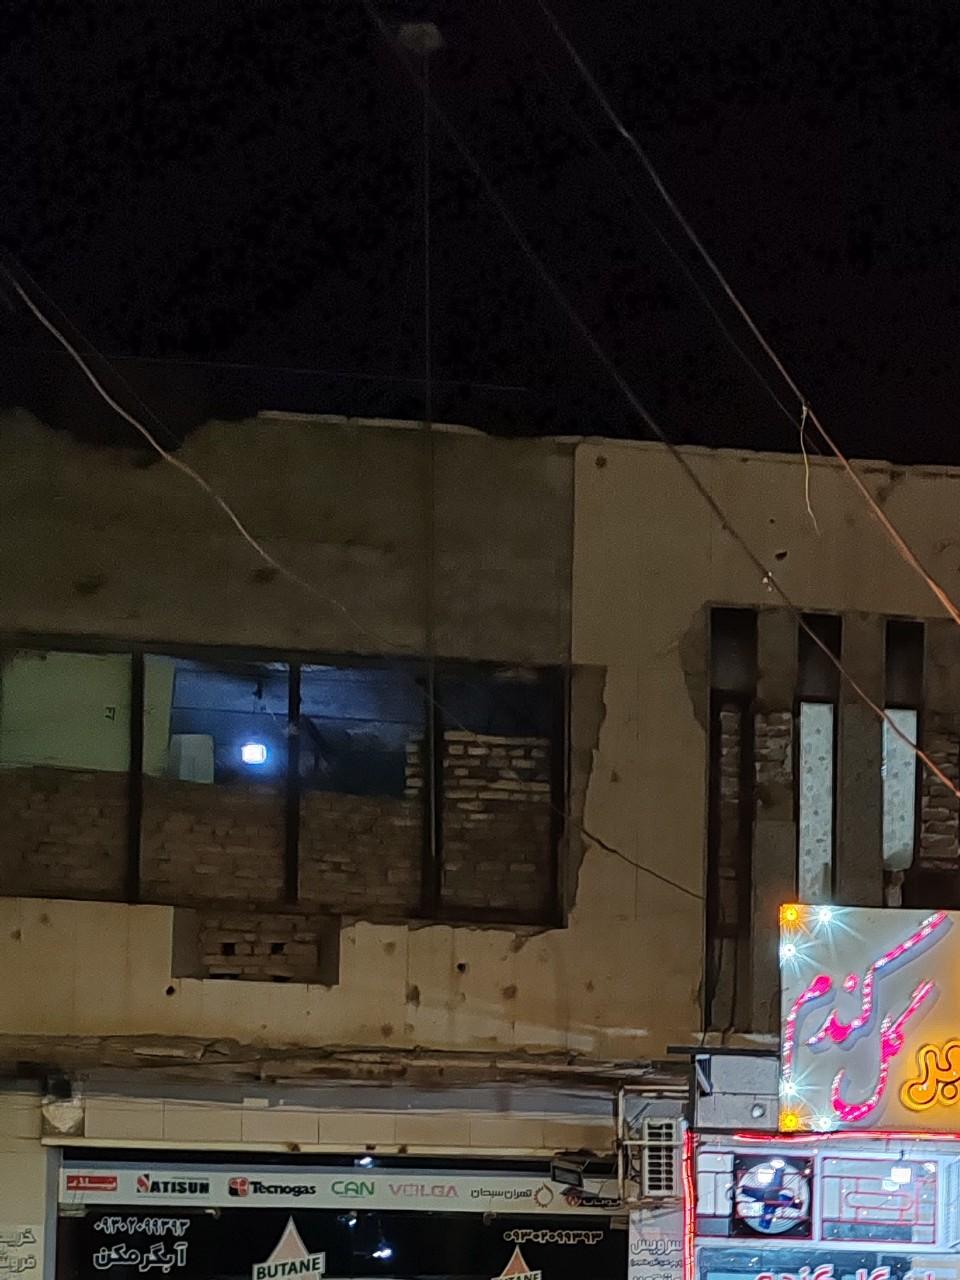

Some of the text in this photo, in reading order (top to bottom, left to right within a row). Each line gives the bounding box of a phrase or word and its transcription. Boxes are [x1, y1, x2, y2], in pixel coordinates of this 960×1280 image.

[249, 1181, 316, 1196] Tecnogas
[331, 1180, 375, 1195] CAN
[93, 1242, 188, 1273] آبگرمکن
[256, 1257, 322, 1280] BUTANE
